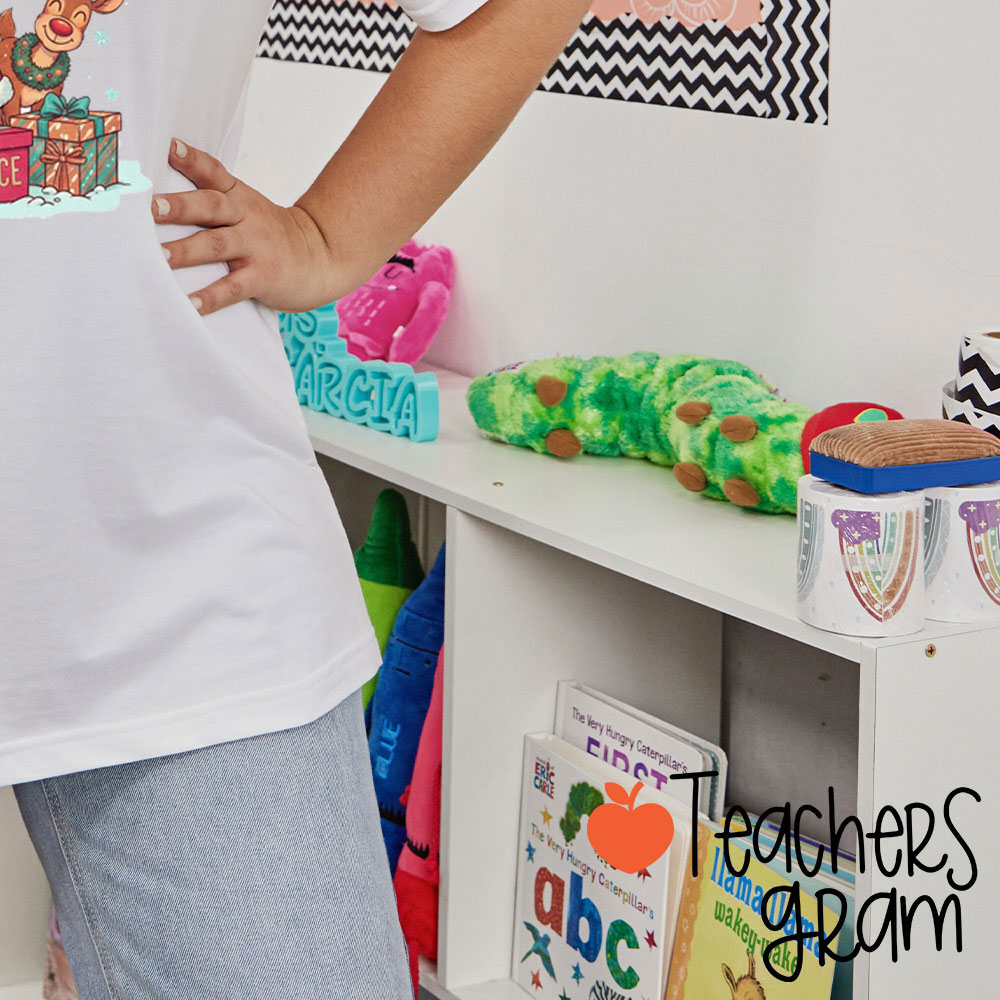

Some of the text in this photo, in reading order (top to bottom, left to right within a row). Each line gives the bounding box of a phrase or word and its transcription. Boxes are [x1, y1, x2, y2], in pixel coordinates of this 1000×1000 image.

[286, 347, 418, 437] ARCIA
[374, 717, 402, 780] BLUE
[534, 761, 555, 786] ERIC
[572, 706, 688, 775] The Very Hungry Caterpillar's
[533, 775, 555, 800] CARLE
[531, 822, 655, 920] The Very Hungry Caterpillar's
[534, 866, 640, 990] abc
